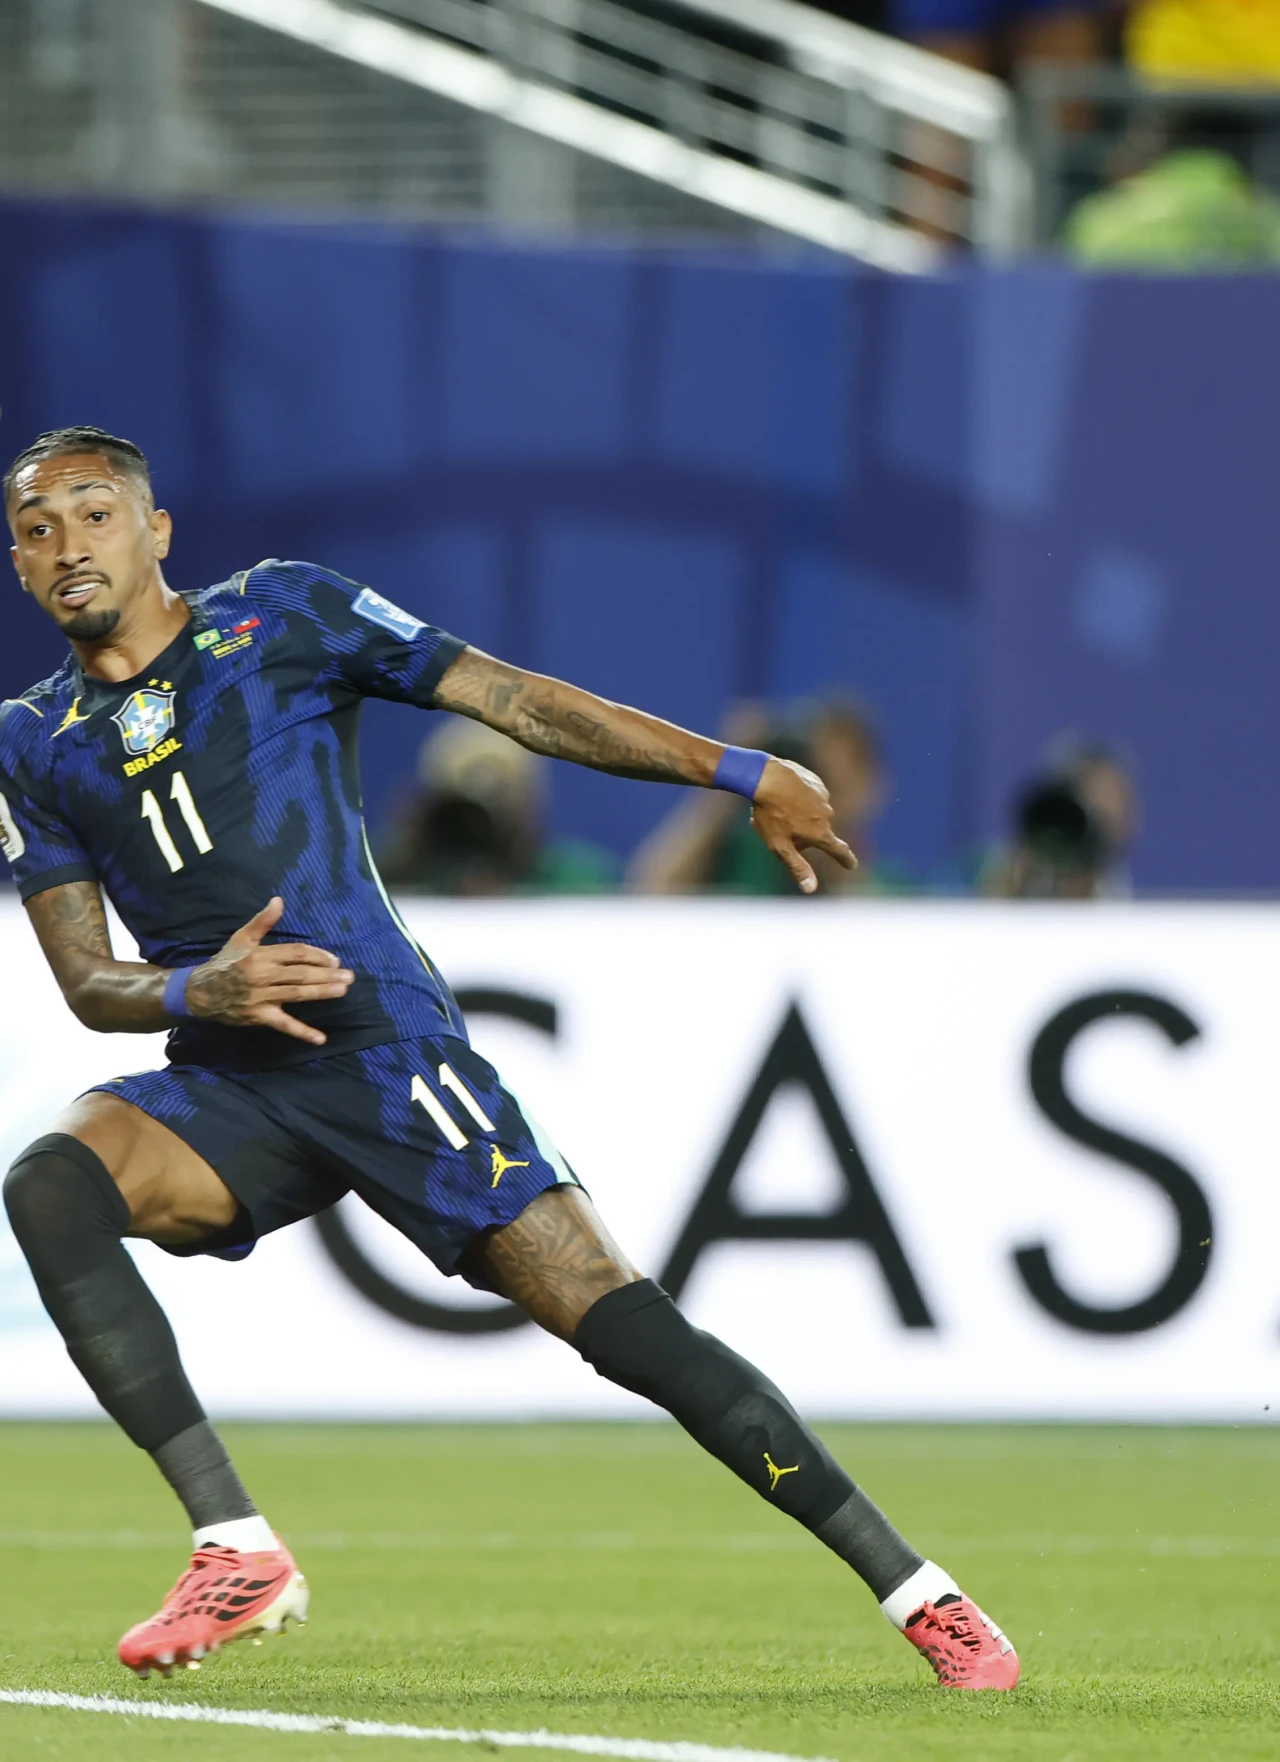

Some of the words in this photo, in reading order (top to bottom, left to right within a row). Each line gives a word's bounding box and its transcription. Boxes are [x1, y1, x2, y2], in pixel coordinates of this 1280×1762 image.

[122, 737, 183, 777] BRASIL
[141, 771, 214, 873] 11
[410, 1062, 497, 1151] 11
